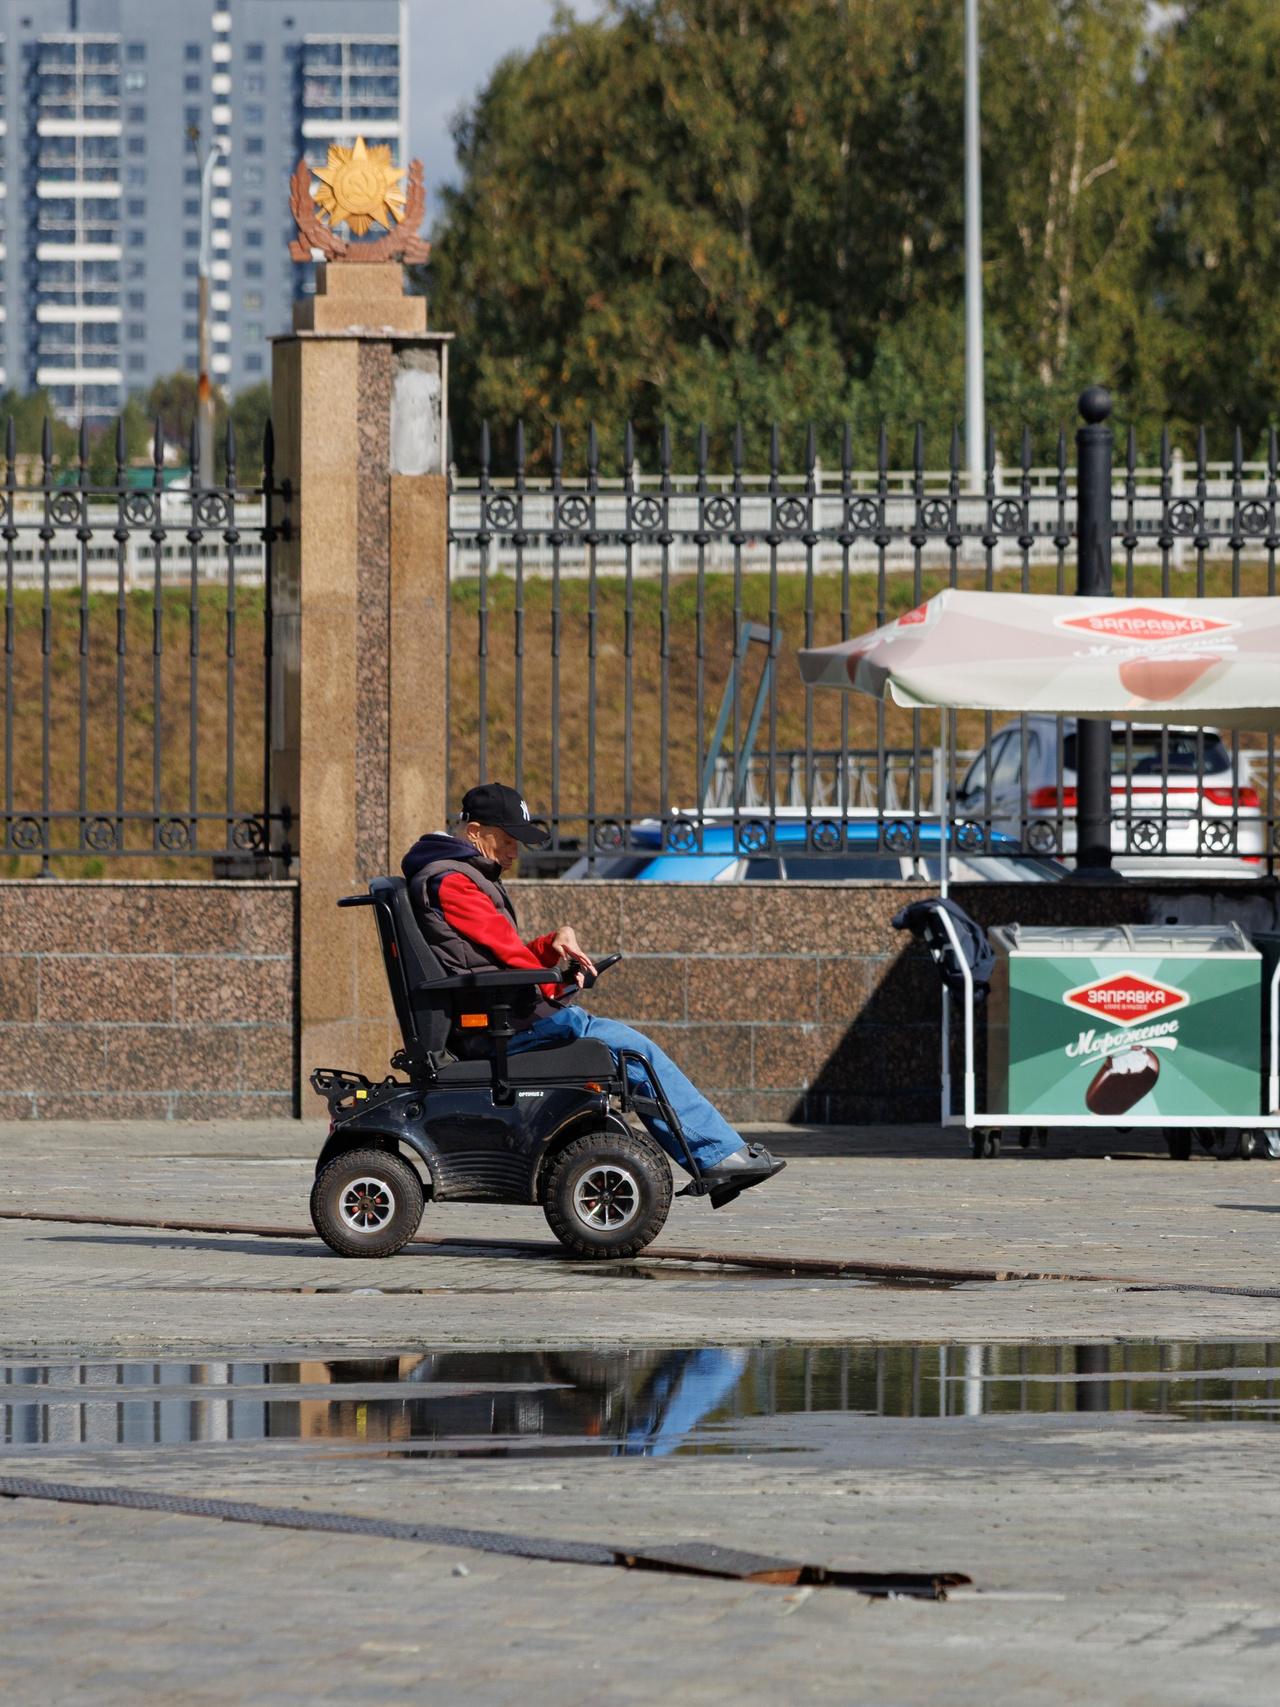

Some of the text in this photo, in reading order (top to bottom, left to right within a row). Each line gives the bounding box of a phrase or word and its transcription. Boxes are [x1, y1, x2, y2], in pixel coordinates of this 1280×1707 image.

[1088, 617, 1206, 632] ЗАПРАВКА
[1087, 990, 1166, 1004] ЗАПРАВКА
[1065, 1019, 1180, 1060] Мороженое
